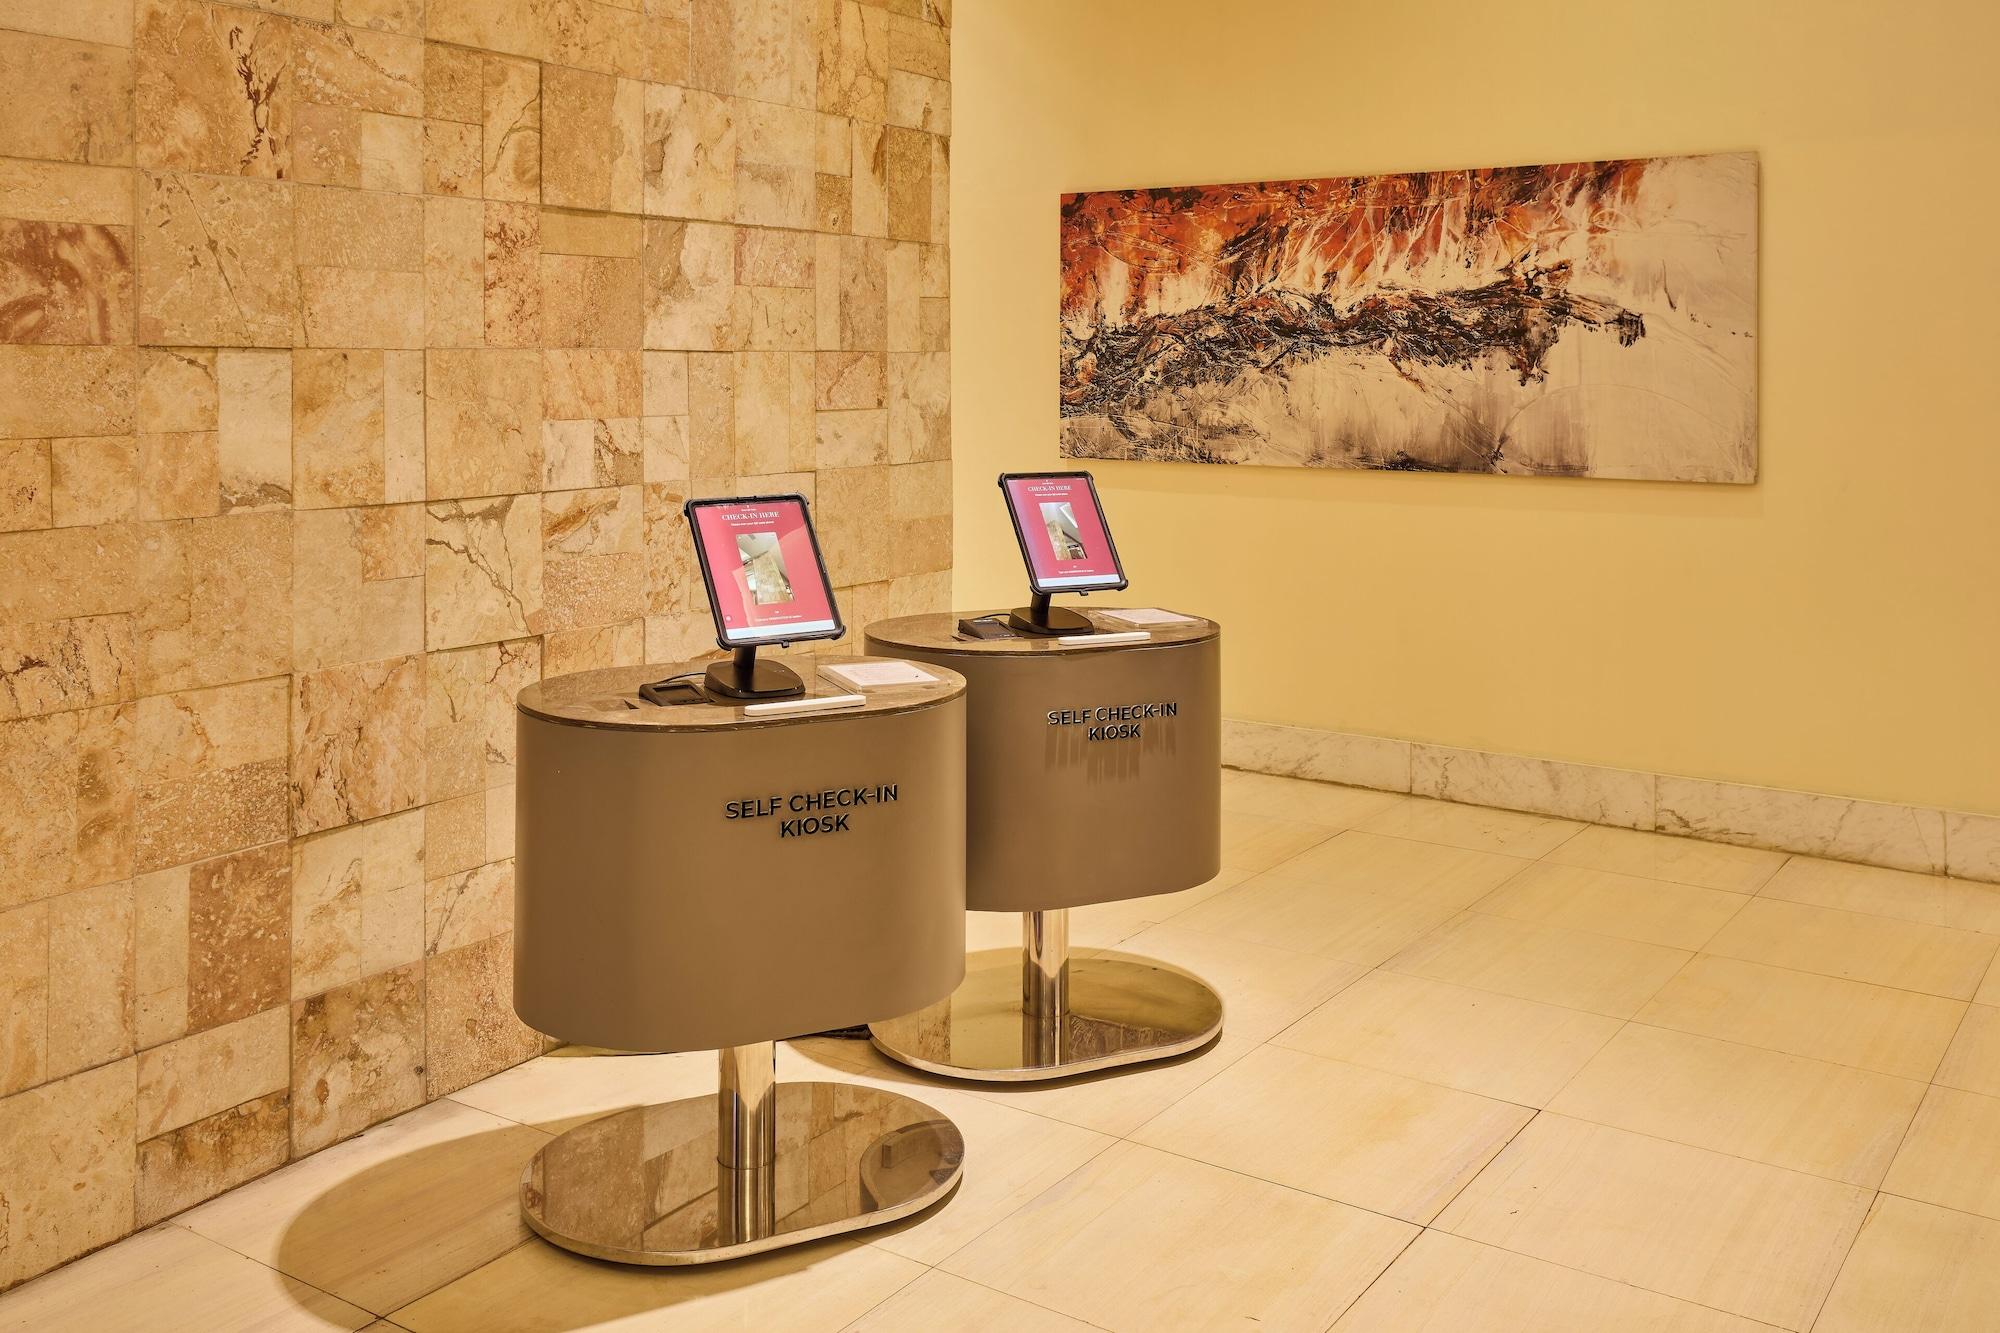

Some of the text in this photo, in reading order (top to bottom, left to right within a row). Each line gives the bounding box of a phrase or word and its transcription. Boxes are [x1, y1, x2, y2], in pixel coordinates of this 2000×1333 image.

[721, 511, 781, 521] CHECK-IN HERE
[1047, 702, 1178, 726] SELF CHECK-IN
[1088, 723, 1141, 742] KIOSK
[725, 783, 898, 820] SELF CHECK-IN
[780, 814, 850, 838] KIOSK
